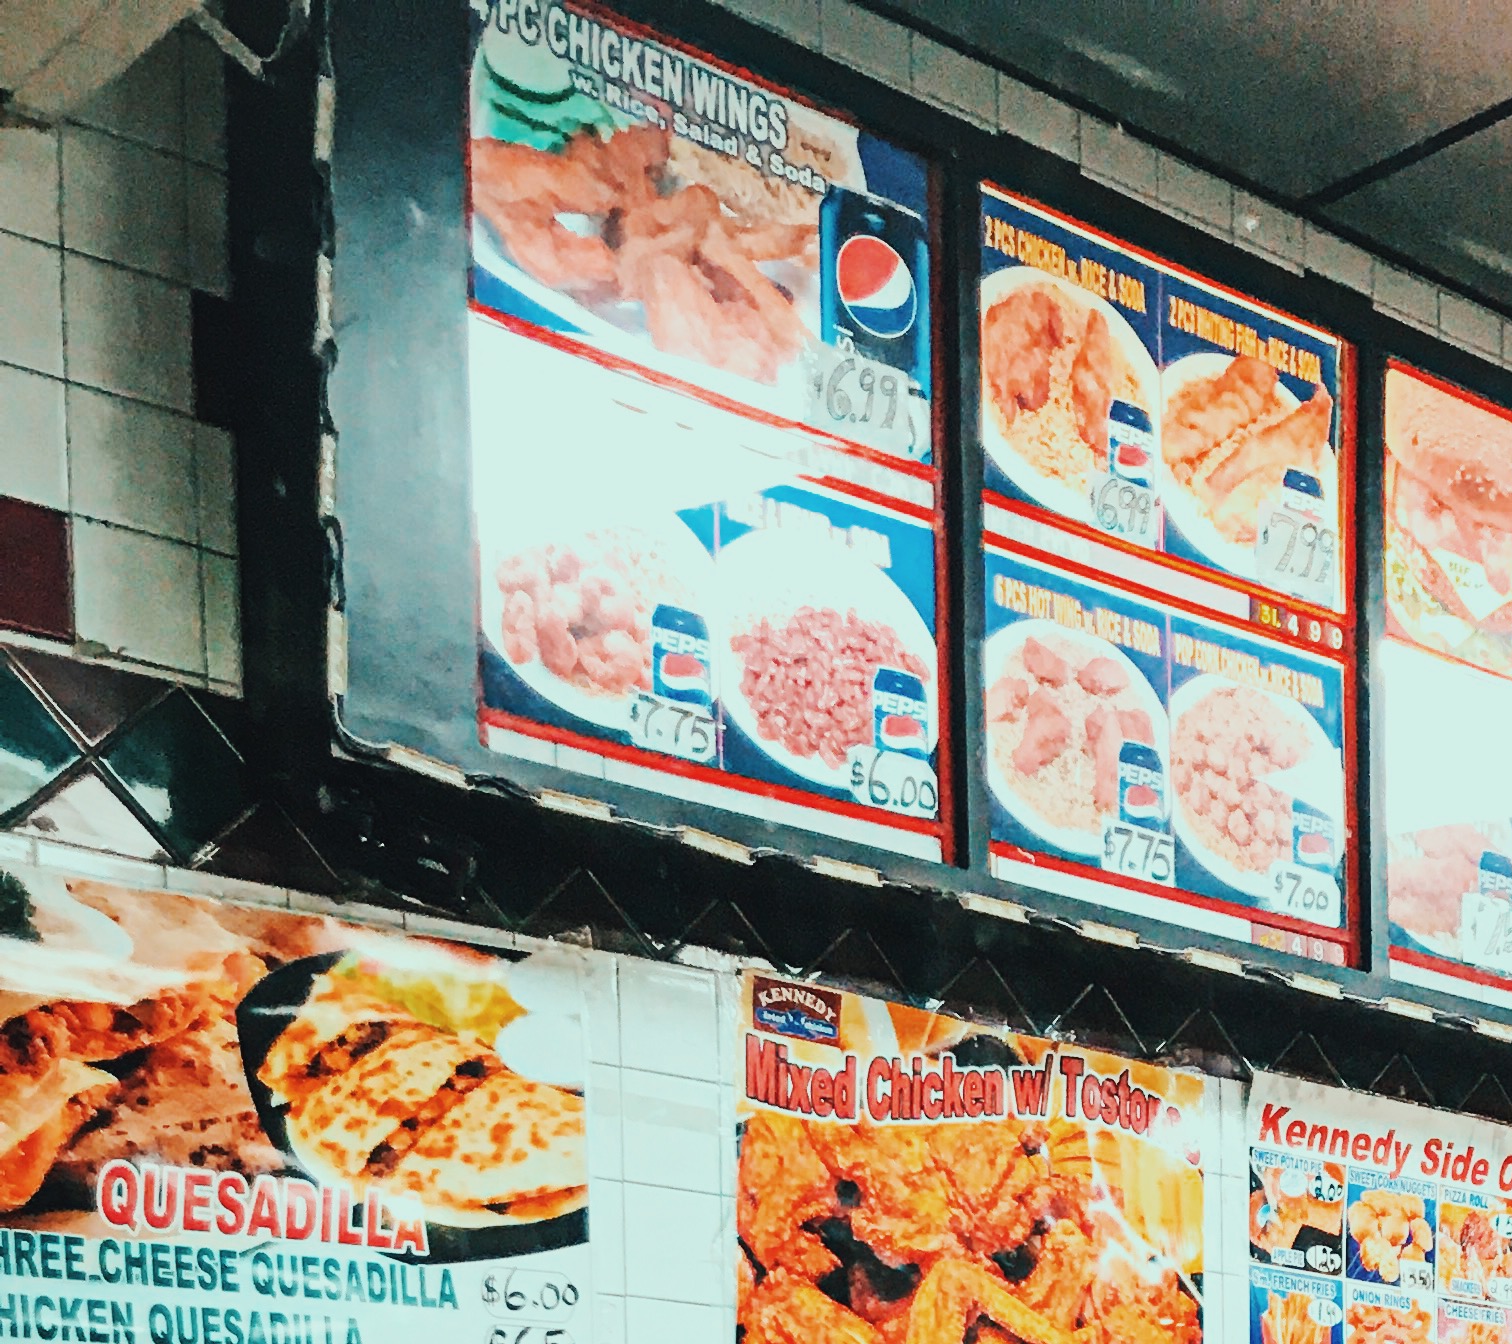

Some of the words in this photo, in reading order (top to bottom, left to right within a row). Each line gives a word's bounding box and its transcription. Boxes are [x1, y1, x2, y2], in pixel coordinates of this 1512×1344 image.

[547, 4, 685, 108] CHICKEN
[692, 66, 789, 151] WINGS
[674, 112, 739, 157] Salad
[746, 143, 762, 168] &
[770, 154, 826, 194] Soda
[758, 987, 836, 1022] KENNEDY
[746, 1032, 857, 1119] Mixed
[867, 1054, 1004, 1120] Chicken
[1012, 1053, 1054, 1117] w/
[1259, 1103, 1413, 1180] Kennedy
[1421, 1138, 1489, 1186] Side
[101, 1163, 428, 1253] QUESADILLA
[1350, 1171, 1376, 1185] SWEET
[1401, 1180, 1435, 1197] NUGGETS
[1444, 1189, 1466, 1203] PIZZA
[1470, 1194, 1488, 1208] ROLL
[0, 1232, 86, 1281] HREE
[100, 1239, 239, 1292] CHEESE
[252, 1251, 459, 1310] QUESADILLA
[1273, 1275, 1309, 1292] FRENCH
[1311, 1282, 1335, 1297] FRIES
[1353, 1289, 1380, 1306] ONION
[1382, 1293, 1411, 1310] RINGS
[1445, 1306, 1478, 1320] CHEESE
[1481, 1310, 1504, 1324] FRIES
